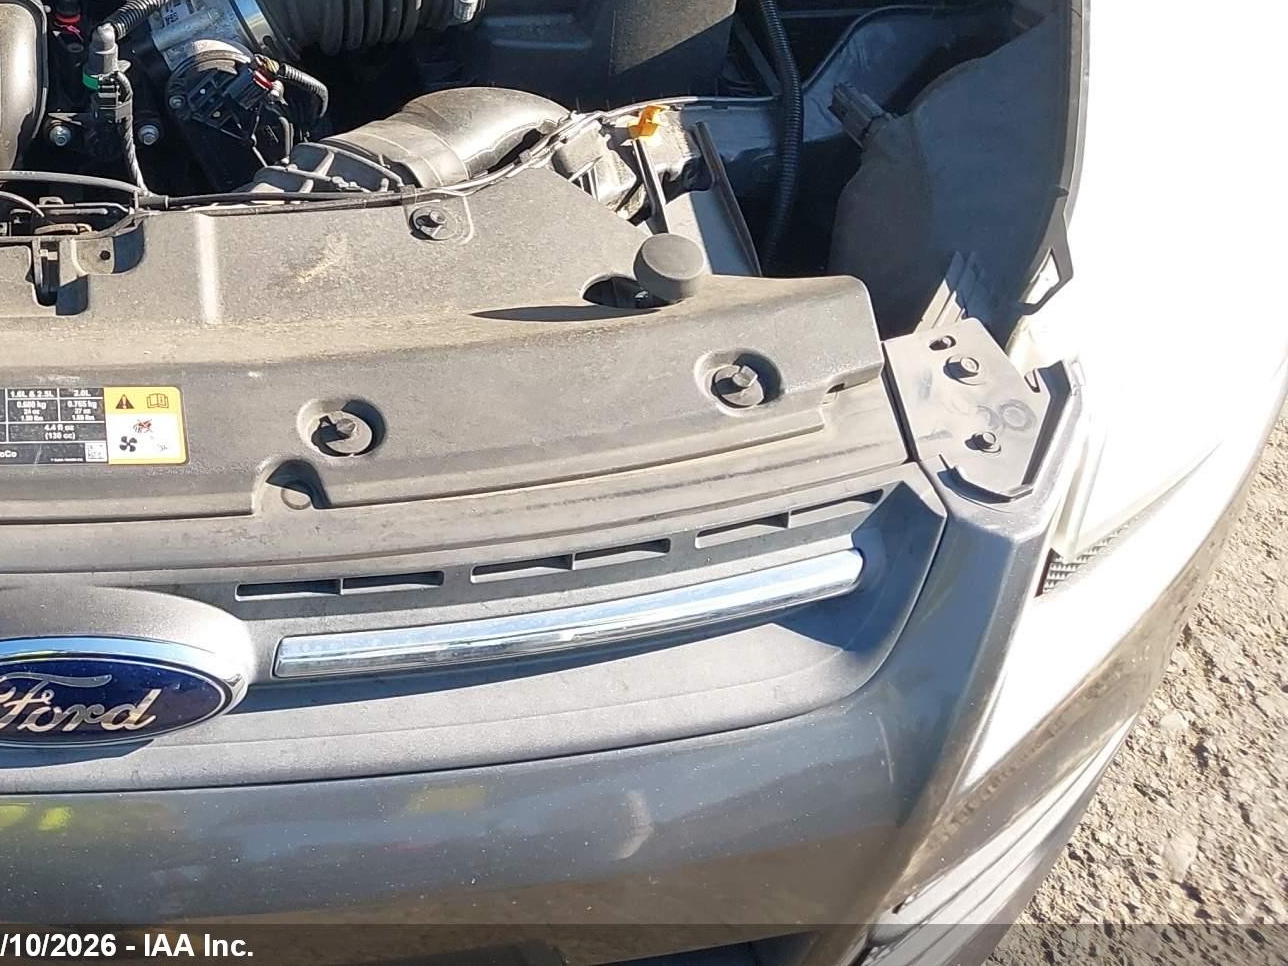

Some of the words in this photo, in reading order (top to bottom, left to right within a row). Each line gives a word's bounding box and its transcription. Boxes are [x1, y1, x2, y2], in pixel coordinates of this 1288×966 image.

[28, 390, 35, 398] &
[73, 389, 91, 397] 2.0L
[36, 400, 47, 410] kg
[88, 400, 97, 410] kg
